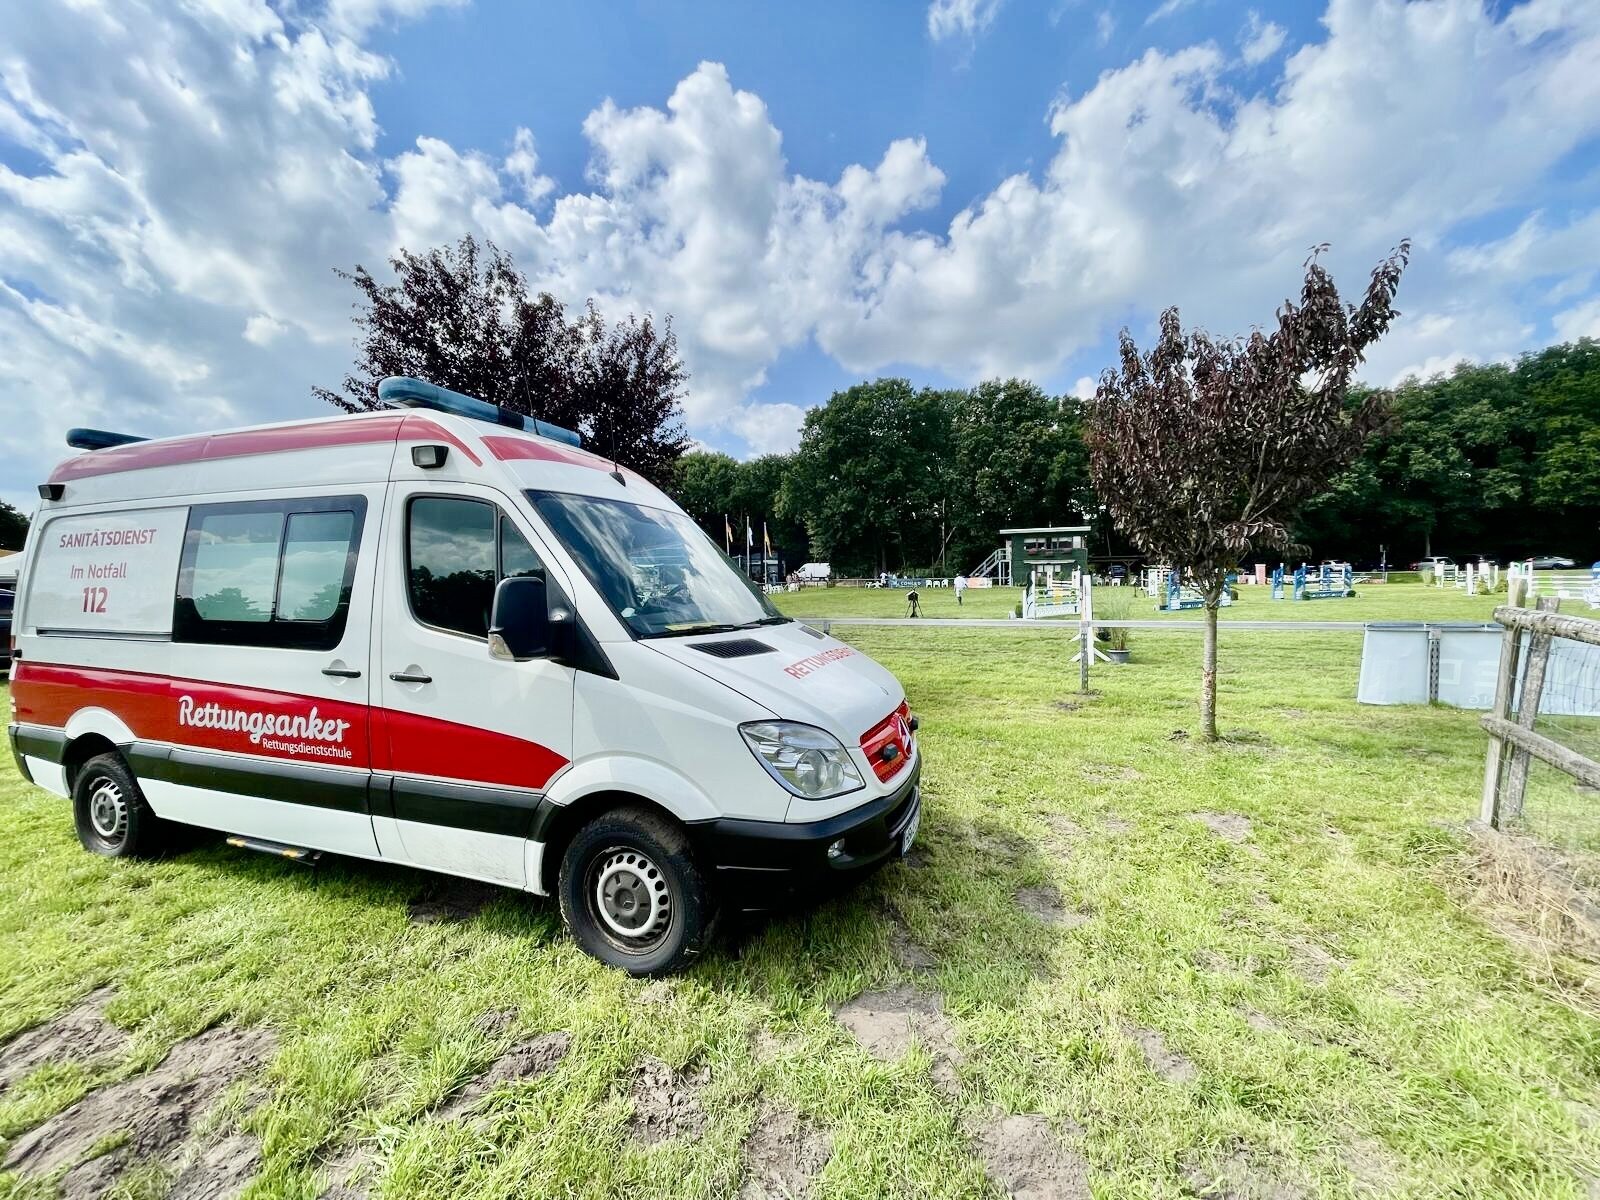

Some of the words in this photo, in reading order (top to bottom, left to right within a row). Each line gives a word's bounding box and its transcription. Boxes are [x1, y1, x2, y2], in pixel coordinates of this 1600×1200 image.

[59, 528, 157, 548] SANITÄTSDIENST
[70, 564, 84, 579] Im
[87, 562, 127, 579] Notfall
[83, 586, 108, 613] 112
[178, 695, 350, 743] Rettungsanker
[262, 738, 352, 759] Rettungsdienstschule
